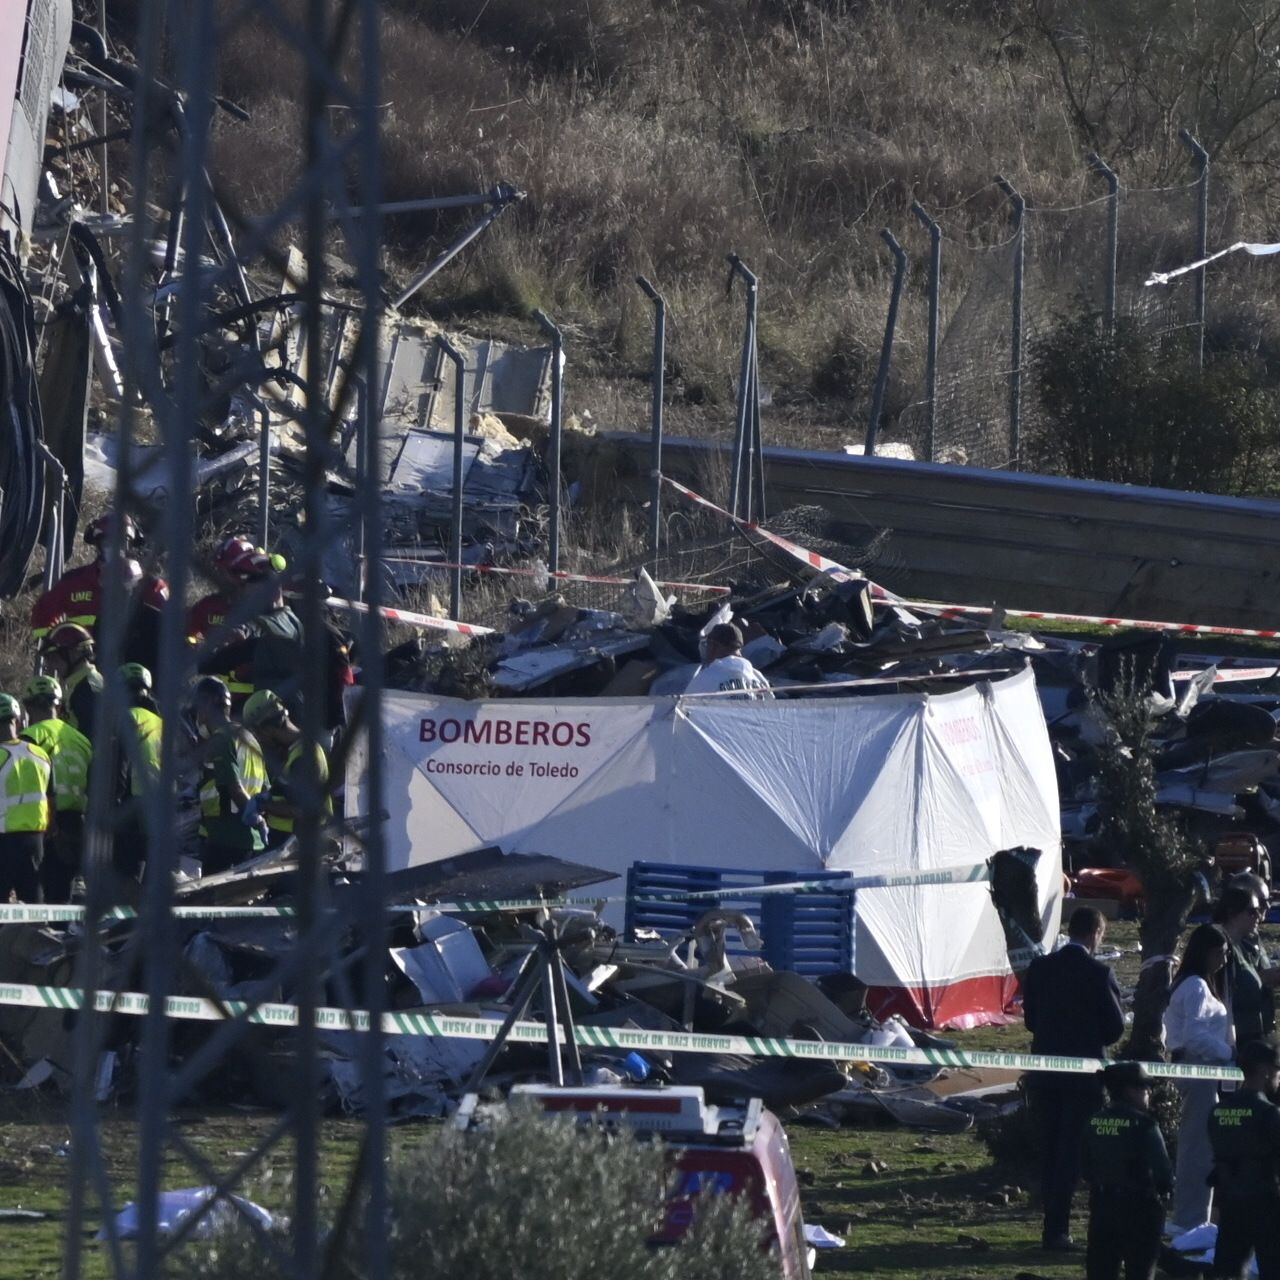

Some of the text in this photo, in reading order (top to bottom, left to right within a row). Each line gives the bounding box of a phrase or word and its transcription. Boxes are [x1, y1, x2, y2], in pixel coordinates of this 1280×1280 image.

[70, 591, 93, 603] UME
[419, 718, 592, 747] BOMBEROS
[426, 758, 579, 778] Consorcio de Toledo
[12, 909, 24, 921] NO
[27, 909, 49, 921] CIVIL
[52, 909, 83, 921] UARDIA
[264, 1007, 296, 1021] PASAR
[442, 1020, 472, 1034] PASAR
[474, 1023, 487, 1035] NO
[619, 1032, 731, 1050] GUARDIA CIVIL NO PASAR
[795, 1044, 907, 1060] GUARDIA CIVIL NO PASAR
[971, 1053, 1083, 1070] GUARDIA CIVIL NO PASAR
[1147, 1064, 1178, 1077] PASAR
[1180, 1065, 1192, 1077] NO
[1196, 1066, 1218, 1078] CIVIL
[1214, 1108, 1253, 1117] GUARDIA
[1091, 1117, 1130, 1128] GUARDIA
[1219, 1116, 1241, 1126] CIVIL
[1096, 1126, 1120, 1136] CIVIL
